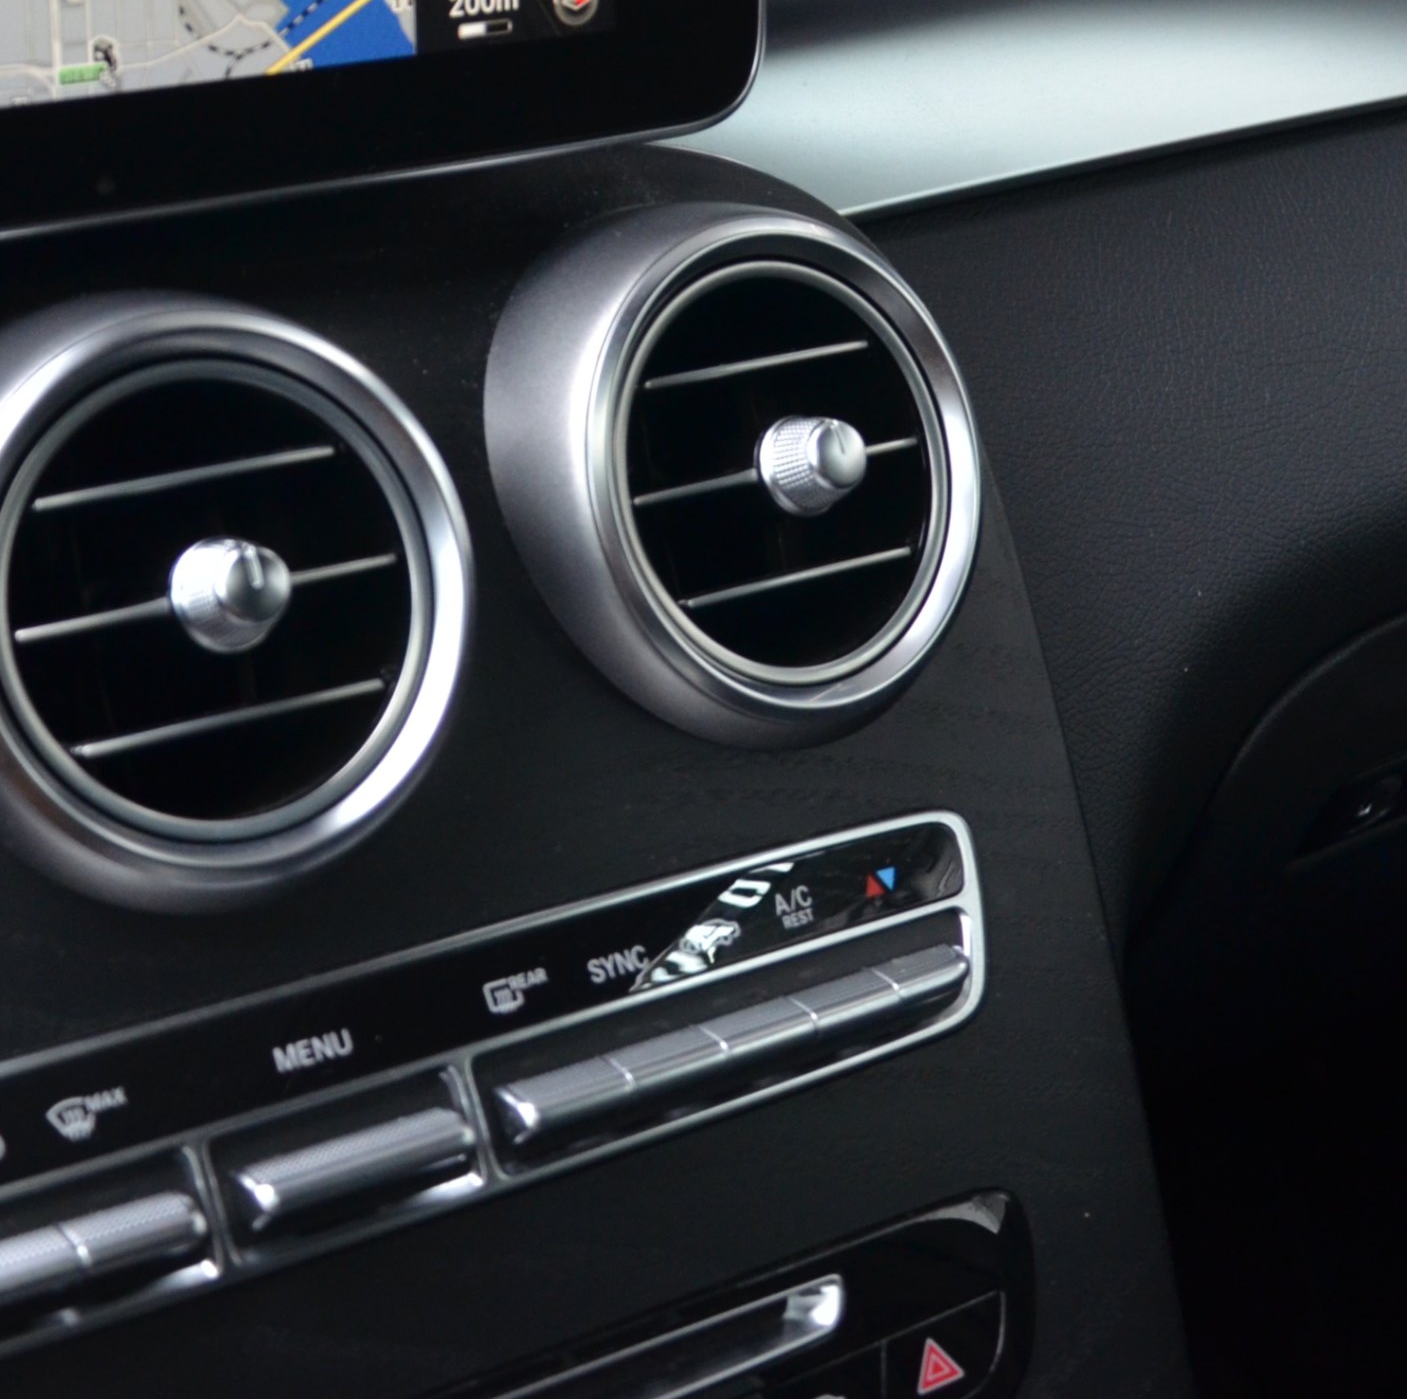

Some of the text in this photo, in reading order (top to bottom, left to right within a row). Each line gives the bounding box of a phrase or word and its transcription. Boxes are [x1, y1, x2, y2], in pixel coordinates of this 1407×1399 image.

[775, 885, 813, 916] A/C
[782, 907, 814, 930] REST
[508, 967, 548, 990] REAR
[586, 945, 652, 984] SYNC
[272, 1029, 354, 1074] MENU
